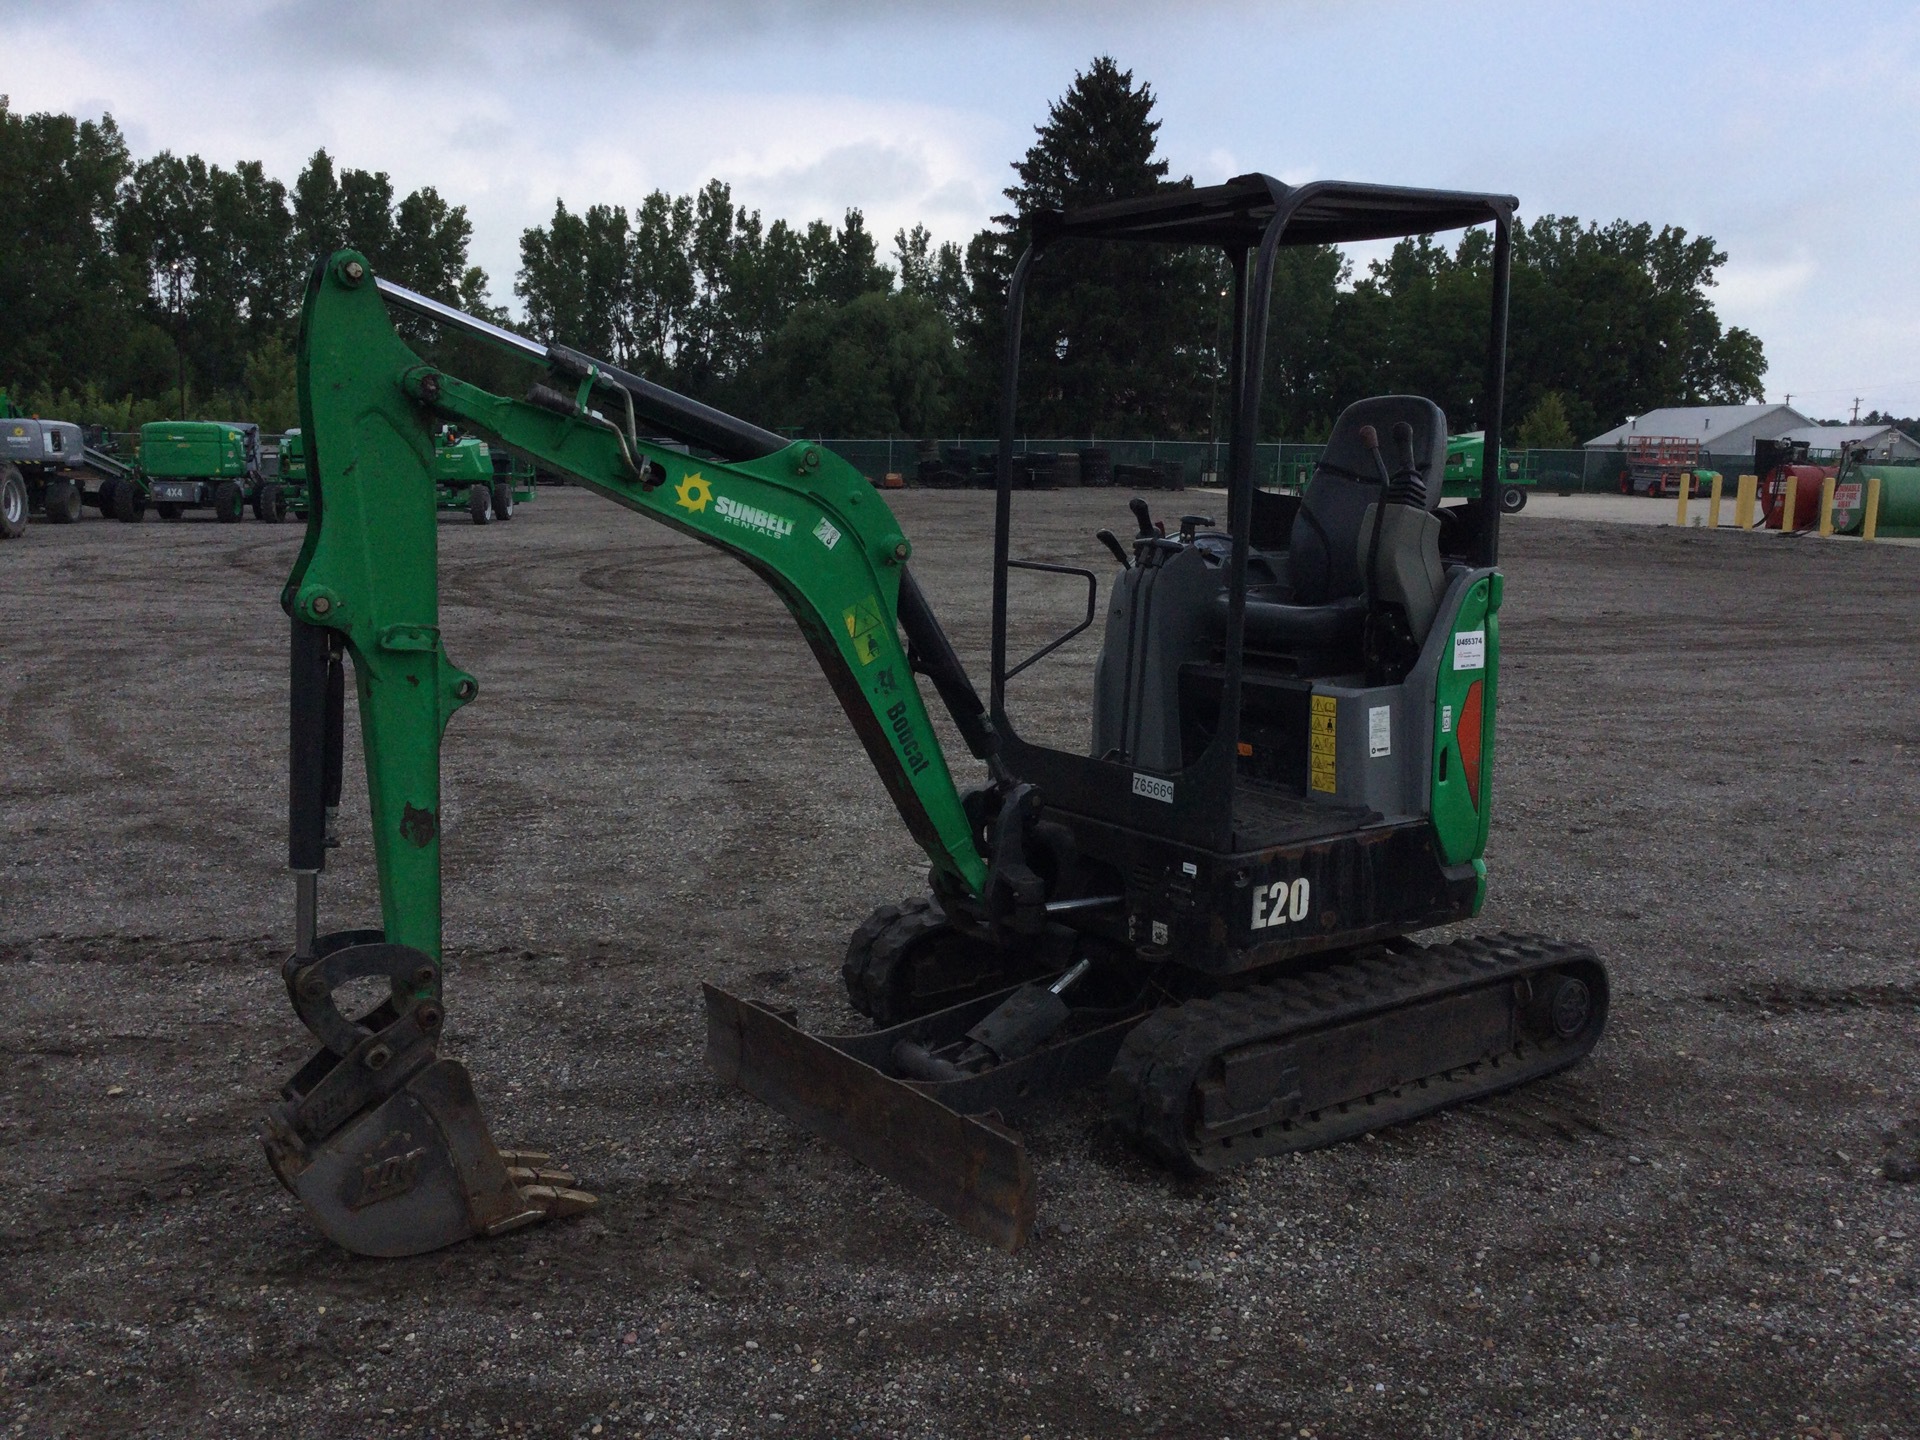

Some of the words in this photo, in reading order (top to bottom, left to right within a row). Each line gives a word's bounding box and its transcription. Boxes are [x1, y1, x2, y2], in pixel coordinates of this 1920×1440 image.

[165, 488, 183, 497] 4X4
[714, 495, 797, 536] SUNBELT
[724, 515, 782, 540] RENTALS
[1134, 776, 1173, 800] 765669
[1250, 877, 1310, 930] E20
